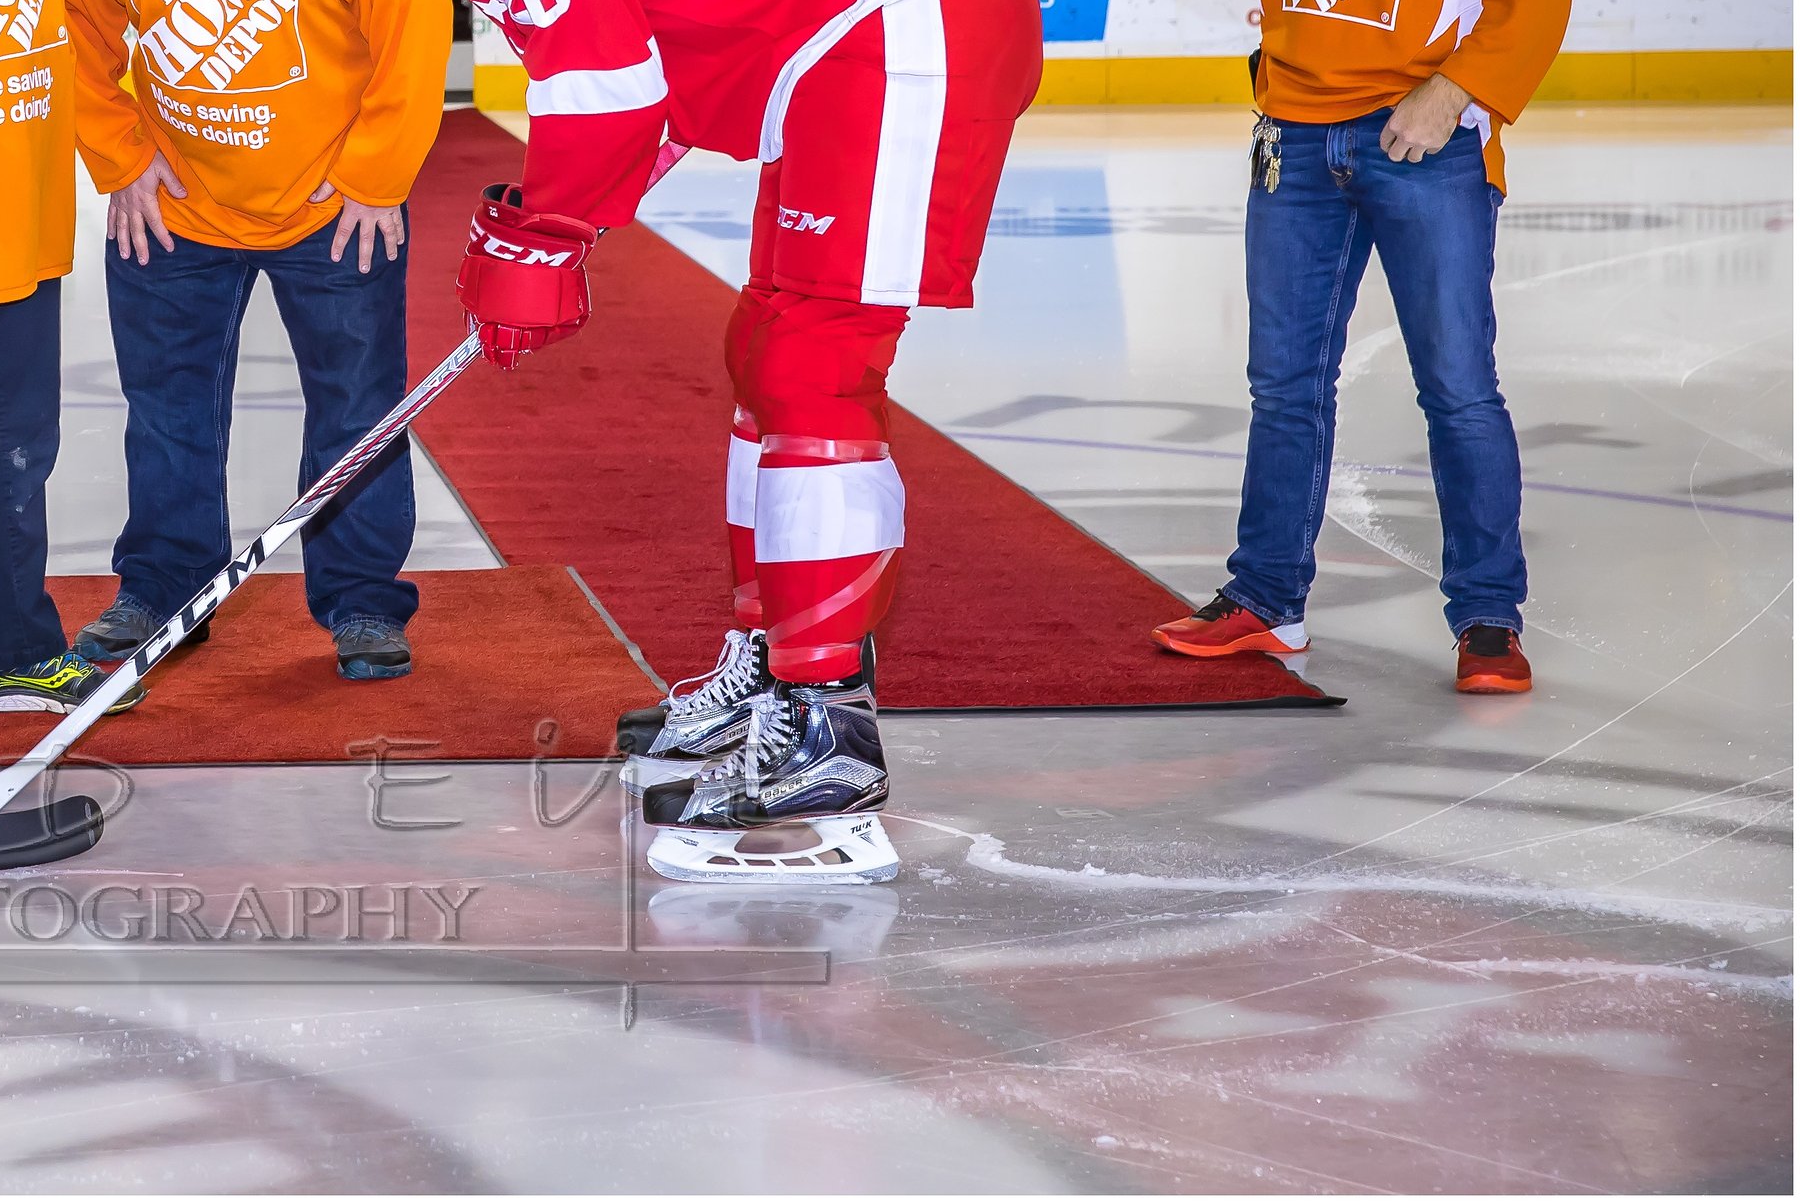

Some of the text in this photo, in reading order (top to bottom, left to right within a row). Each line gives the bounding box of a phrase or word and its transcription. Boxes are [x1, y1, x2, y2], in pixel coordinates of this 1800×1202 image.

[7, 65, 53, 95] saving.
[150, 82, 277, 125] More saving.
[156, 102, 199, 137] More
[777, 204, 837, 235] CM
[135, 535, 267, 678] CCM
